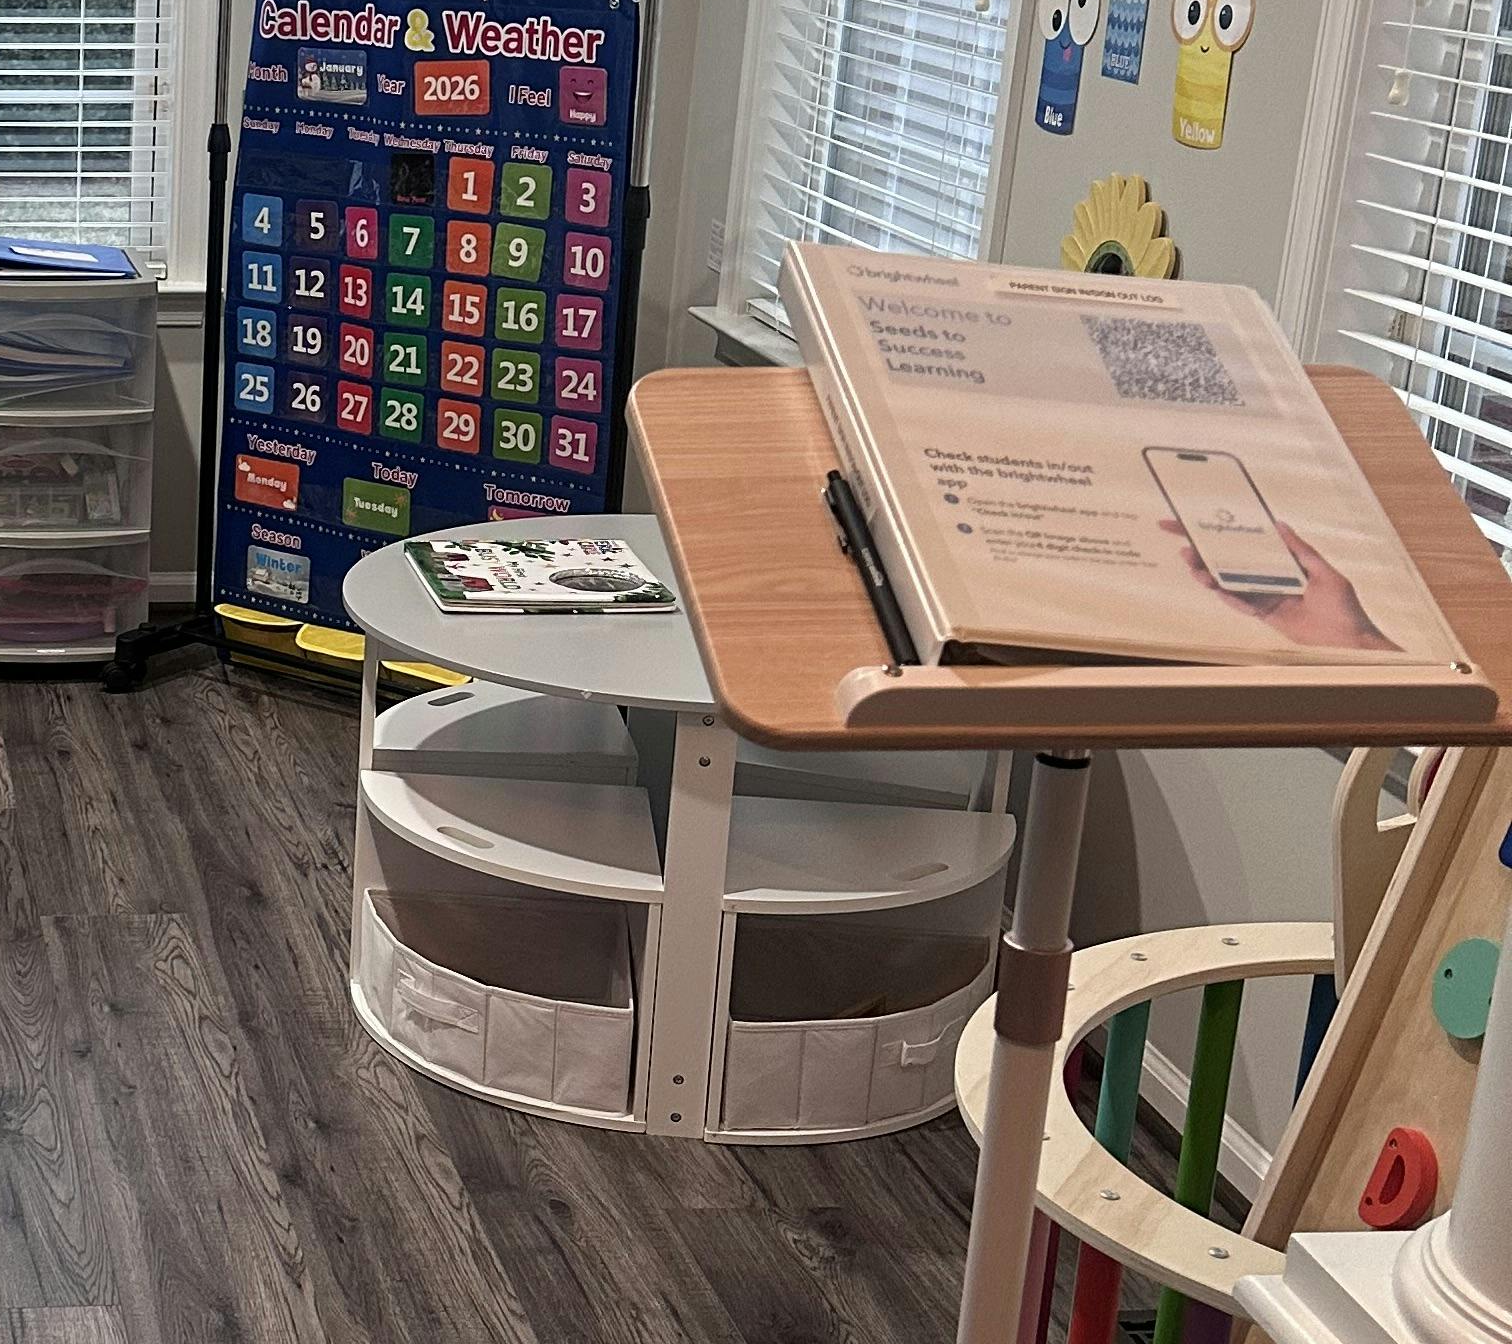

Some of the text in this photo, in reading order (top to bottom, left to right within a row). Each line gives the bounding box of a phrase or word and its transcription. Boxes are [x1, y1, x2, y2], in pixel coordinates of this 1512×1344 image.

[404, 9, 435, 52] &
[443, 11, 603, 61] Weather
[1110, 54, 1130, 71] BLUE
[319, 61, 364, 76] January
[376, 73, 406, 96] Year
[423, 75, 480, 102] 2026
[509, 85, 515, 103] I
[518, 86, 552, 108] Feel
[569, 109, 596, 123] Happy
[1044, 106, 1064, 127] Blue
[243, 116, 612, 170] Sunday Monday Wednesday Thursday Friday Saturday
[1179, 119, 1216, 145] Yellow
[461, 171, 597, 214] 1 2 3
[253, 207, 604, 278] 4 5 6 7 8 9 10
[864, 267, 960, 287] brightwheel
[246, 263, 598, 339] 11 12 13 14 15 16 17
[857, 296, 1012, 326] Welcome to
[869, 320, 966, 343] Seeds to
[242, 317, 597, 401] 18 19 20 21 22 23 24
[878, 338, 966, 360] Success
[886, 357, 985, 384] Learning
[238, 373, 591, 462] 25 26 27 28 29 30 31
[246, 433, 317, 465] Yesterday
[924, 448, 1095, 474] Check students in/out
[246, 471, 288, 491] Monday
[371, 461, 419, 489] Today
[931, 462, 1093, 487] with the brightwheel
[937, 477, 968, 490] app
[352, 495, 399, 519] Tuesday
[484, 483, 571, 513] Tomorrow
[250, 523, 302, 550] Season
[255, 551, 304, 576] Winter
